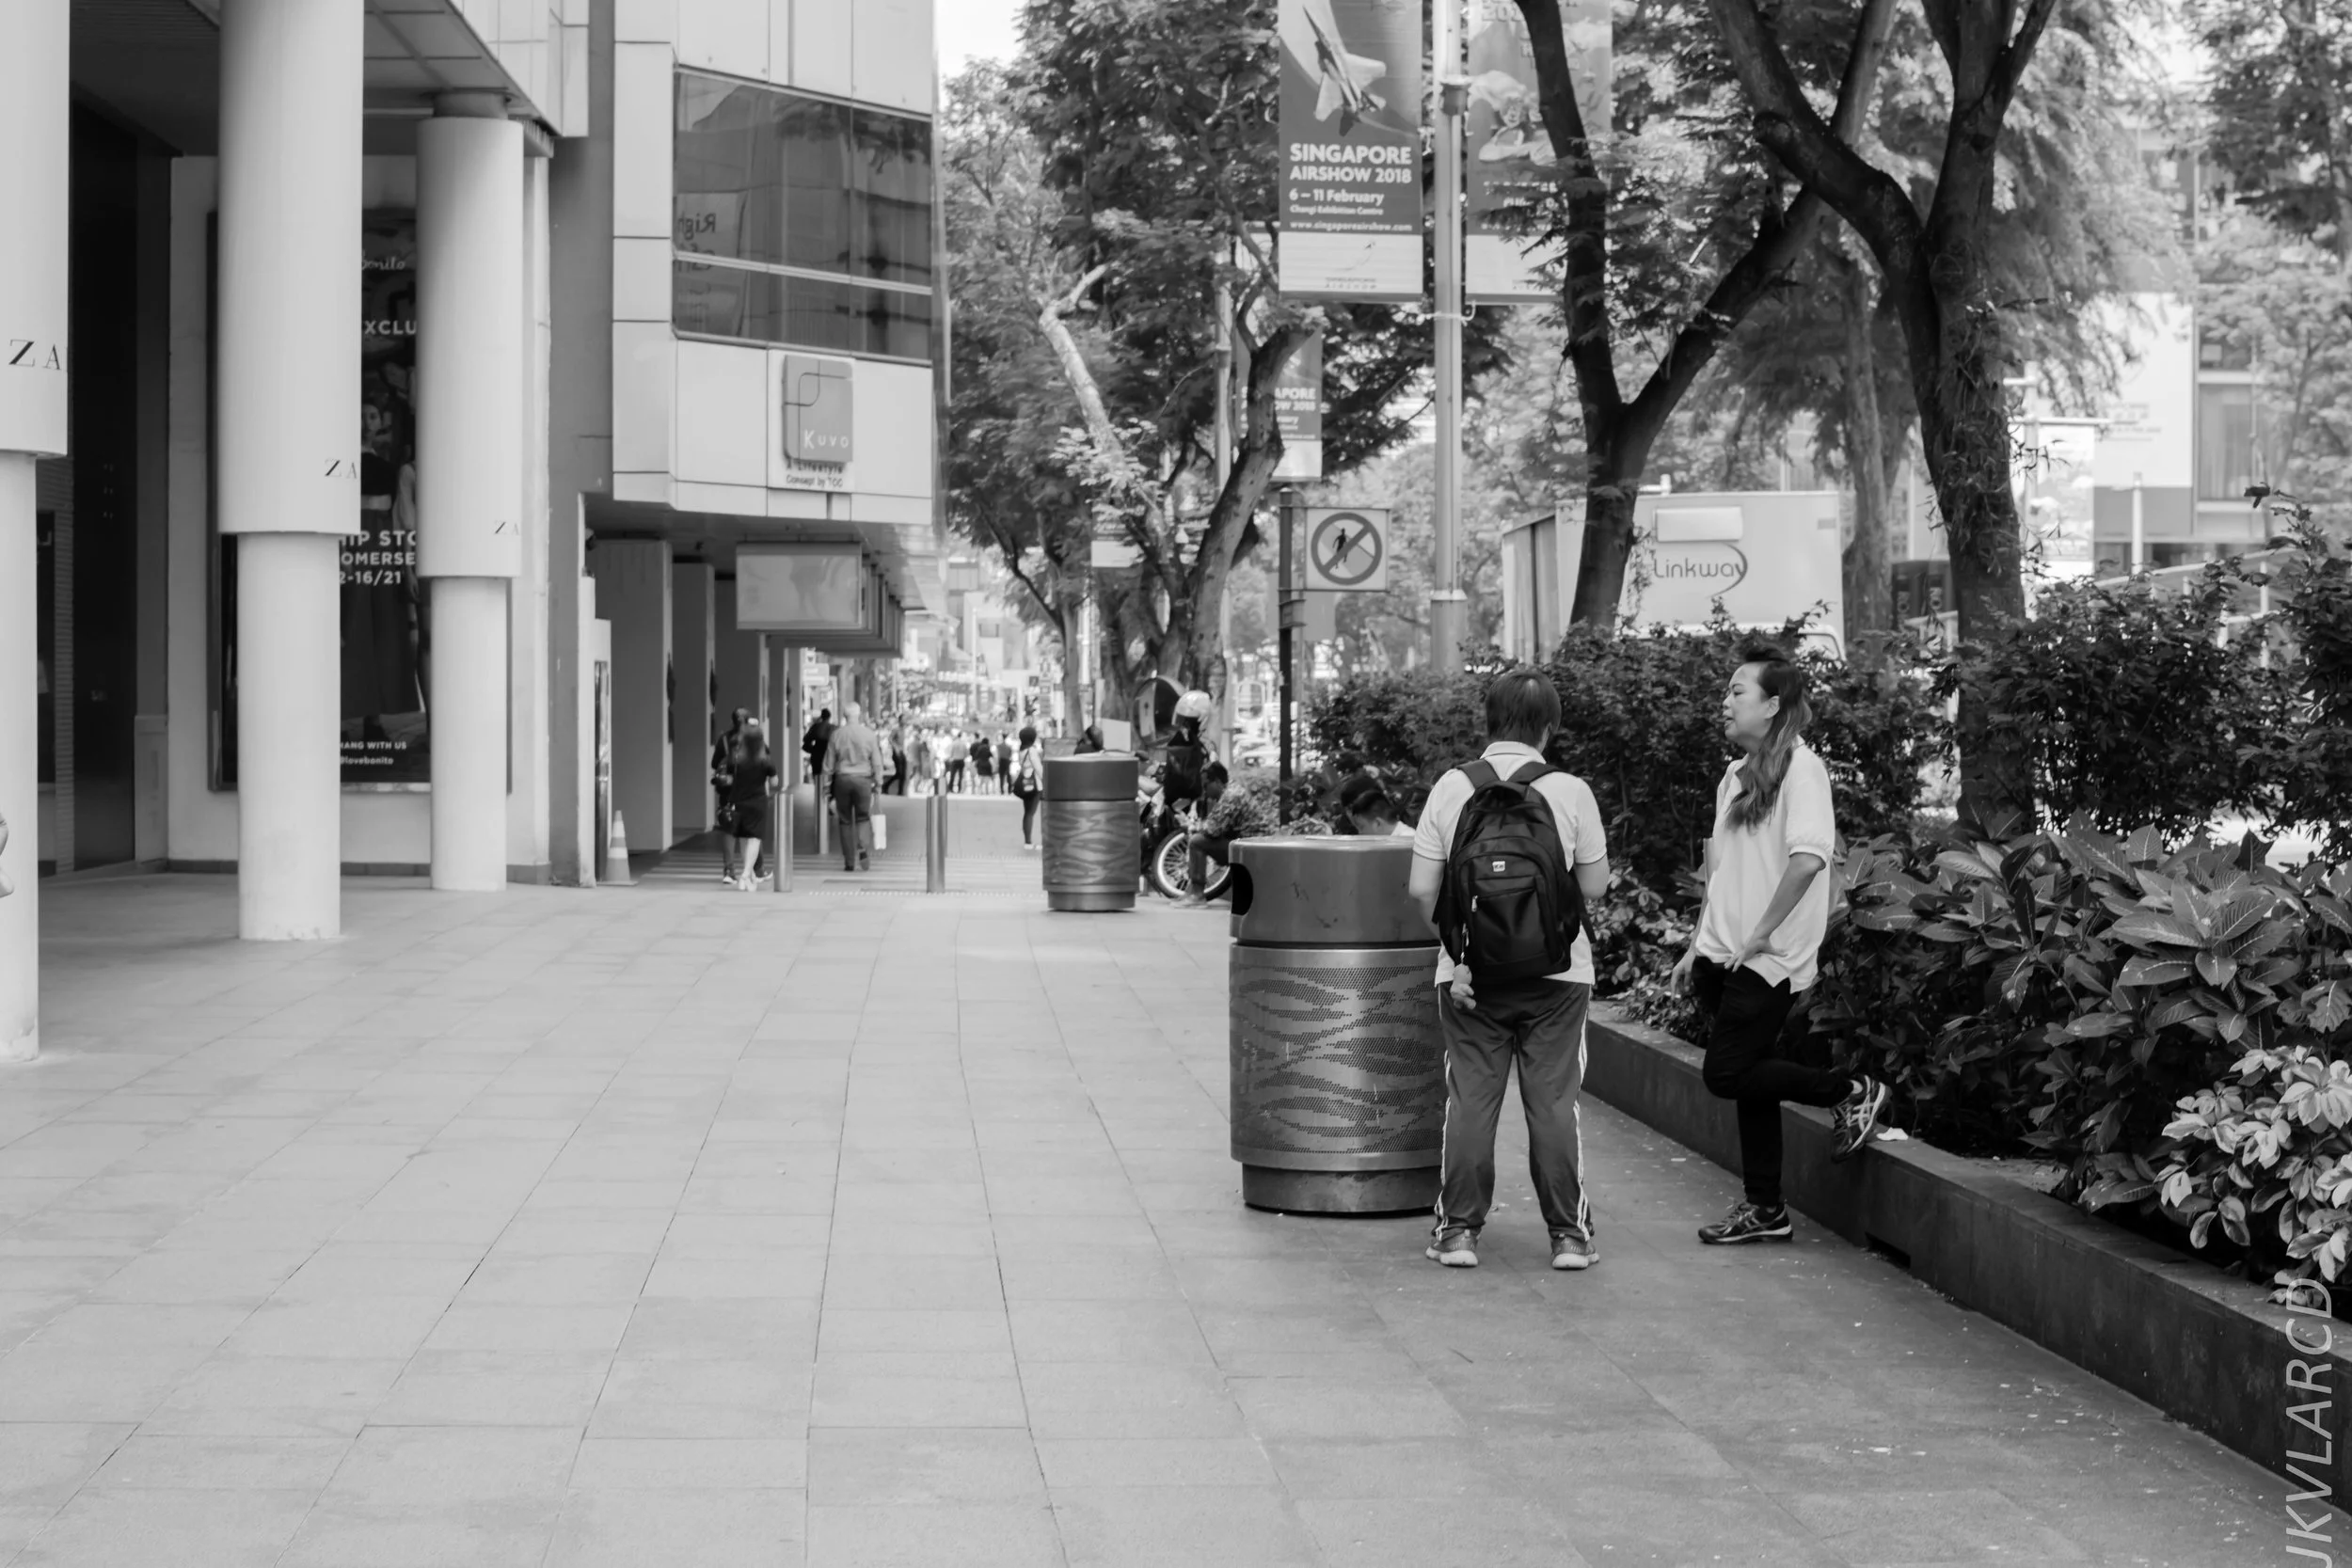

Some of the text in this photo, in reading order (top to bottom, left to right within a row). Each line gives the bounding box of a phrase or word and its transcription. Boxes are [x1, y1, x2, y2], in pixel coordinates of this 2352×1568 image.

[1290, 143, 1412, 165] SINGAPORE
[1290, 166, 1412, 183] AIRSHOW 2018
[1289, 188, 1298, 201] 6
[1313, 189, 1325, 201] 11
[1327, 189, 1385, 206] February
[8, 339, 68, 372] ZA
[341, 530, 371, 546] IP
[367, 741, 392, 750] WITH
[394, 741, 407, 750] US
